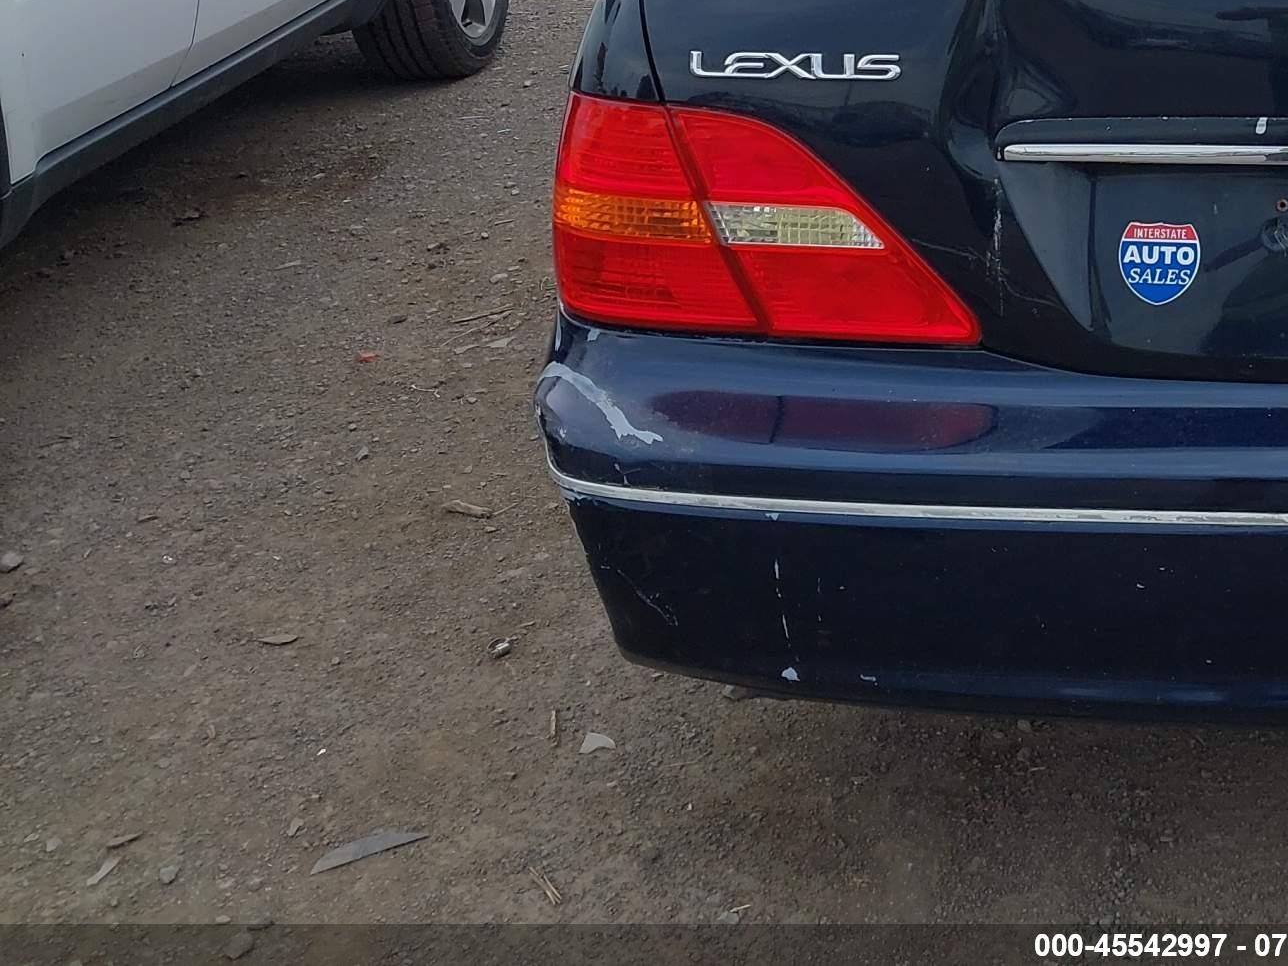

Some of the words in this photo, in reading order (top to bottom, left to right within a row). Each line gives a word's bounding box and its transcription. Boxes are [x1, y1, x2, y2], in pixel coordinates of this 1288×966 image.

[690, 50, 901, 80] LEXUS
[1133, 227, 1188, 240] INTERSTATE
[1122, 244, 1196, 266] AUTO
[1128, 267, 1191, 286] SALES
